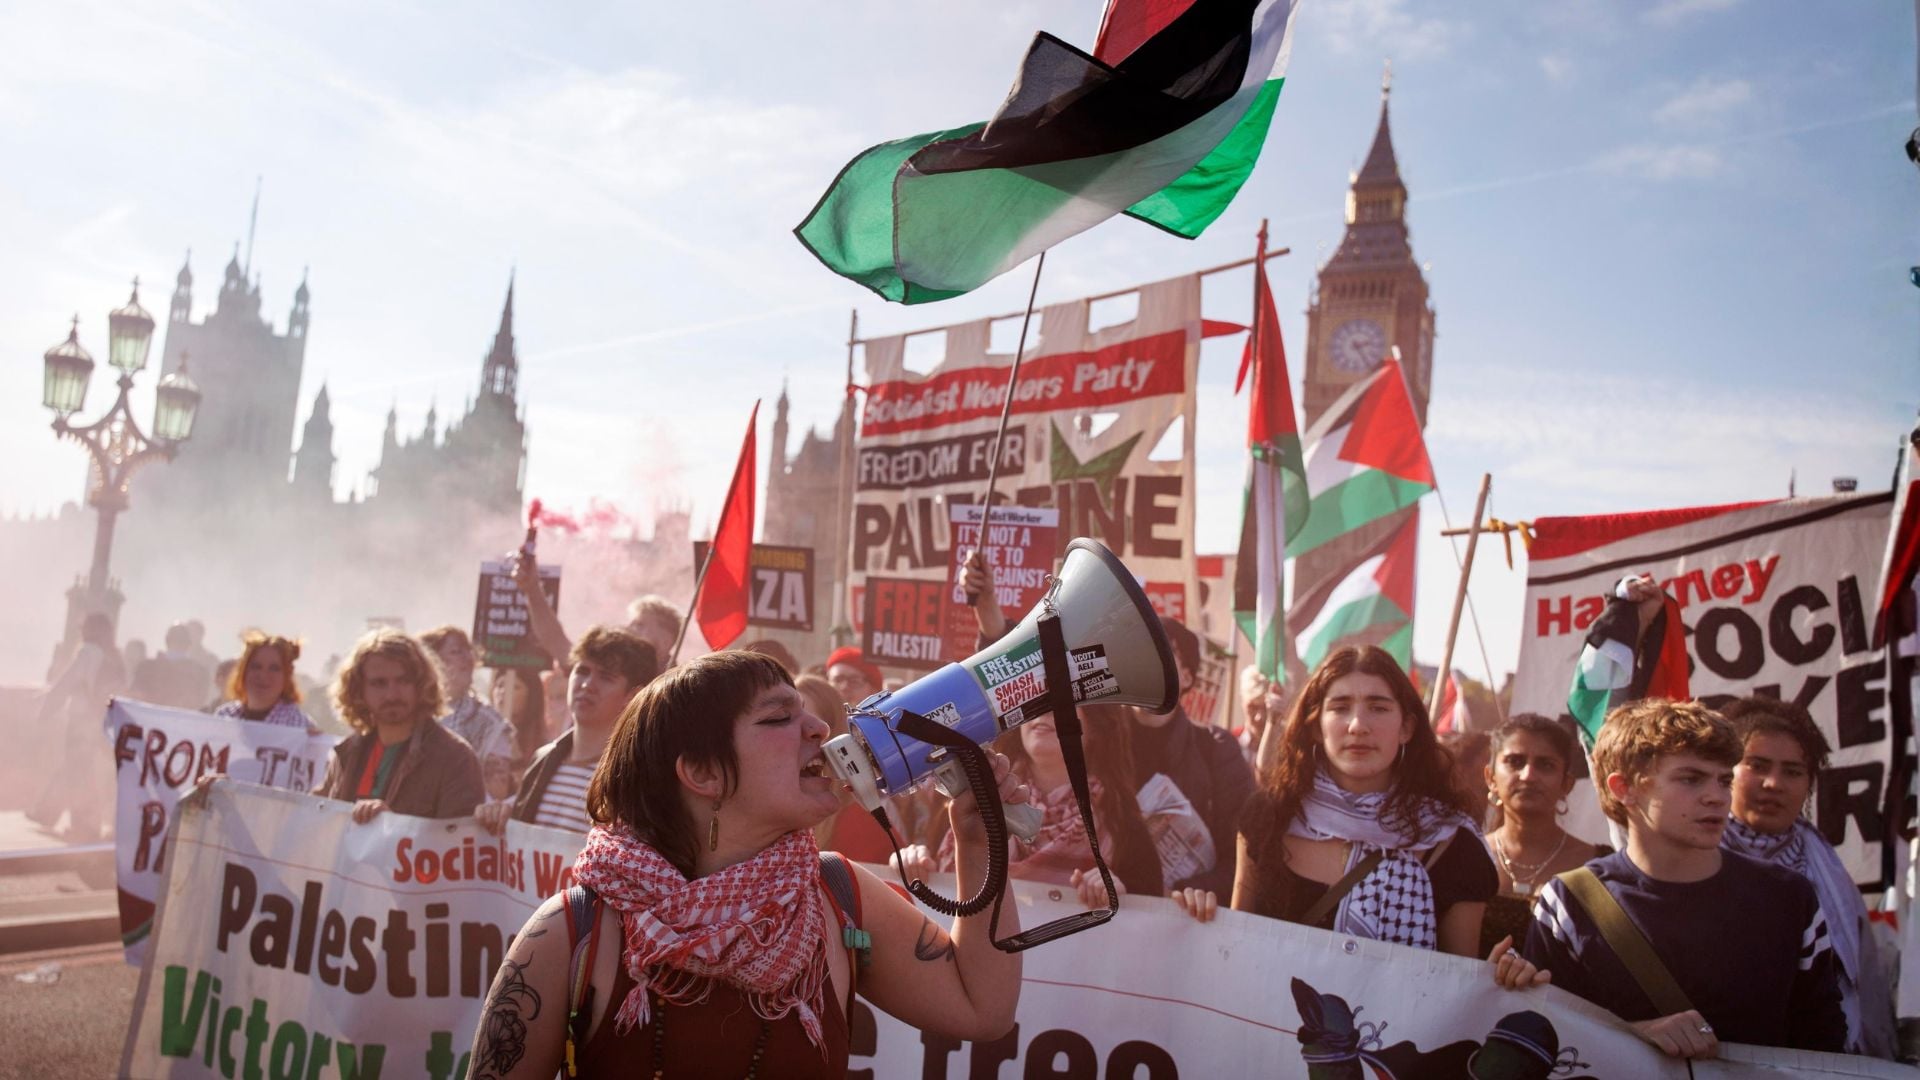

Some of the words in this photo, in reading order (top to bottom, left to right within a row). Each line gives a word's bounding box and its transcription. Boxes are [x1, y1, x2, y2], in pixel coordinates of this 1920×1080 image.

[864, 380, 959, 426] Socialist
[1072, 357, 1156, 394] Party
[969, 434, 1024, 473] FOR
[853, 475, 1183, 572] PALINE
[988, 525, 1018, 545] NOT
[1020, 527, 1032, 547] A
[992, 565, 1047, 589] GAINST
[1004, 547, 1024, 567] TO
[749, 569, 807, 622] ZA
[875, 581, 946, 635] FRE
[1537, 554, 1780, 637] Haney
[1683, 575, 1869, 680] OCI
[980, 654, 1012, 674] FREE
[994, 671, 1035, 701] SMASH
[115, 723, 231, 788] FROM
[255, 746, 318, 793] TH
[393, 837, 526, 893] Socialist
[160, 964, 387, 1080] Victory
